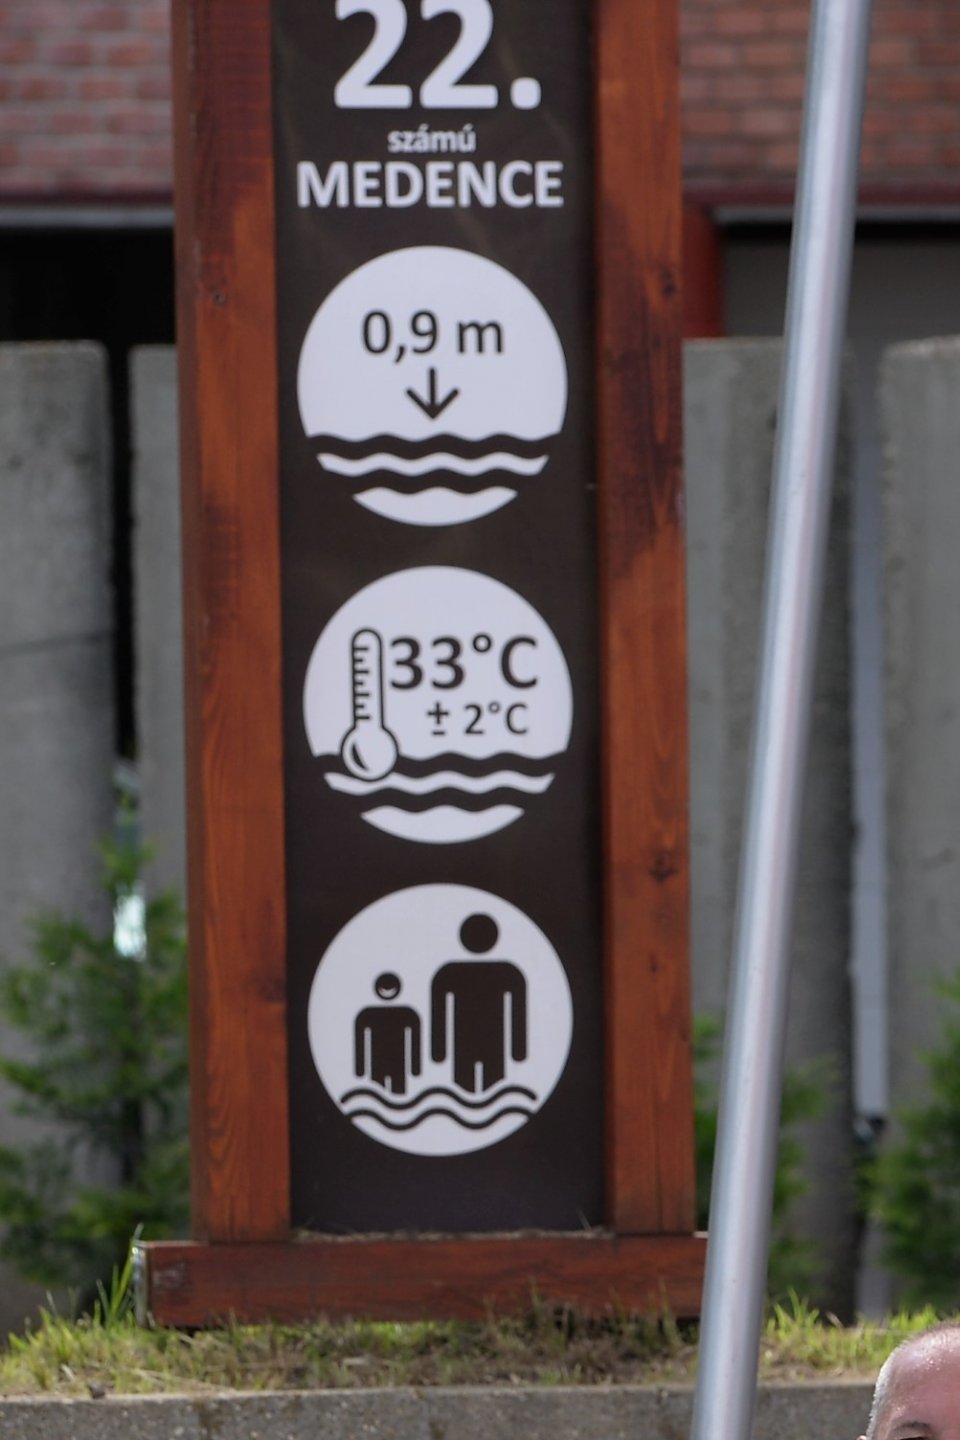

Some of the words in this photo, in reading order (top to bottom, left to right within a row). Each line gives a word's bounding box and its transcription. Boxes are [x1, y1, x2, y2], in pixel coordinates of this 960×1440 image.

[333, 0, 542, 110] 22.
[387, 123, 477, 153] számú
[297, 160, 564, 208] MEDENCE
[361, 309, 438, 364] 0,9
[456, 319, 504, 355] m
[389, 633, 540, 691] 33°C
